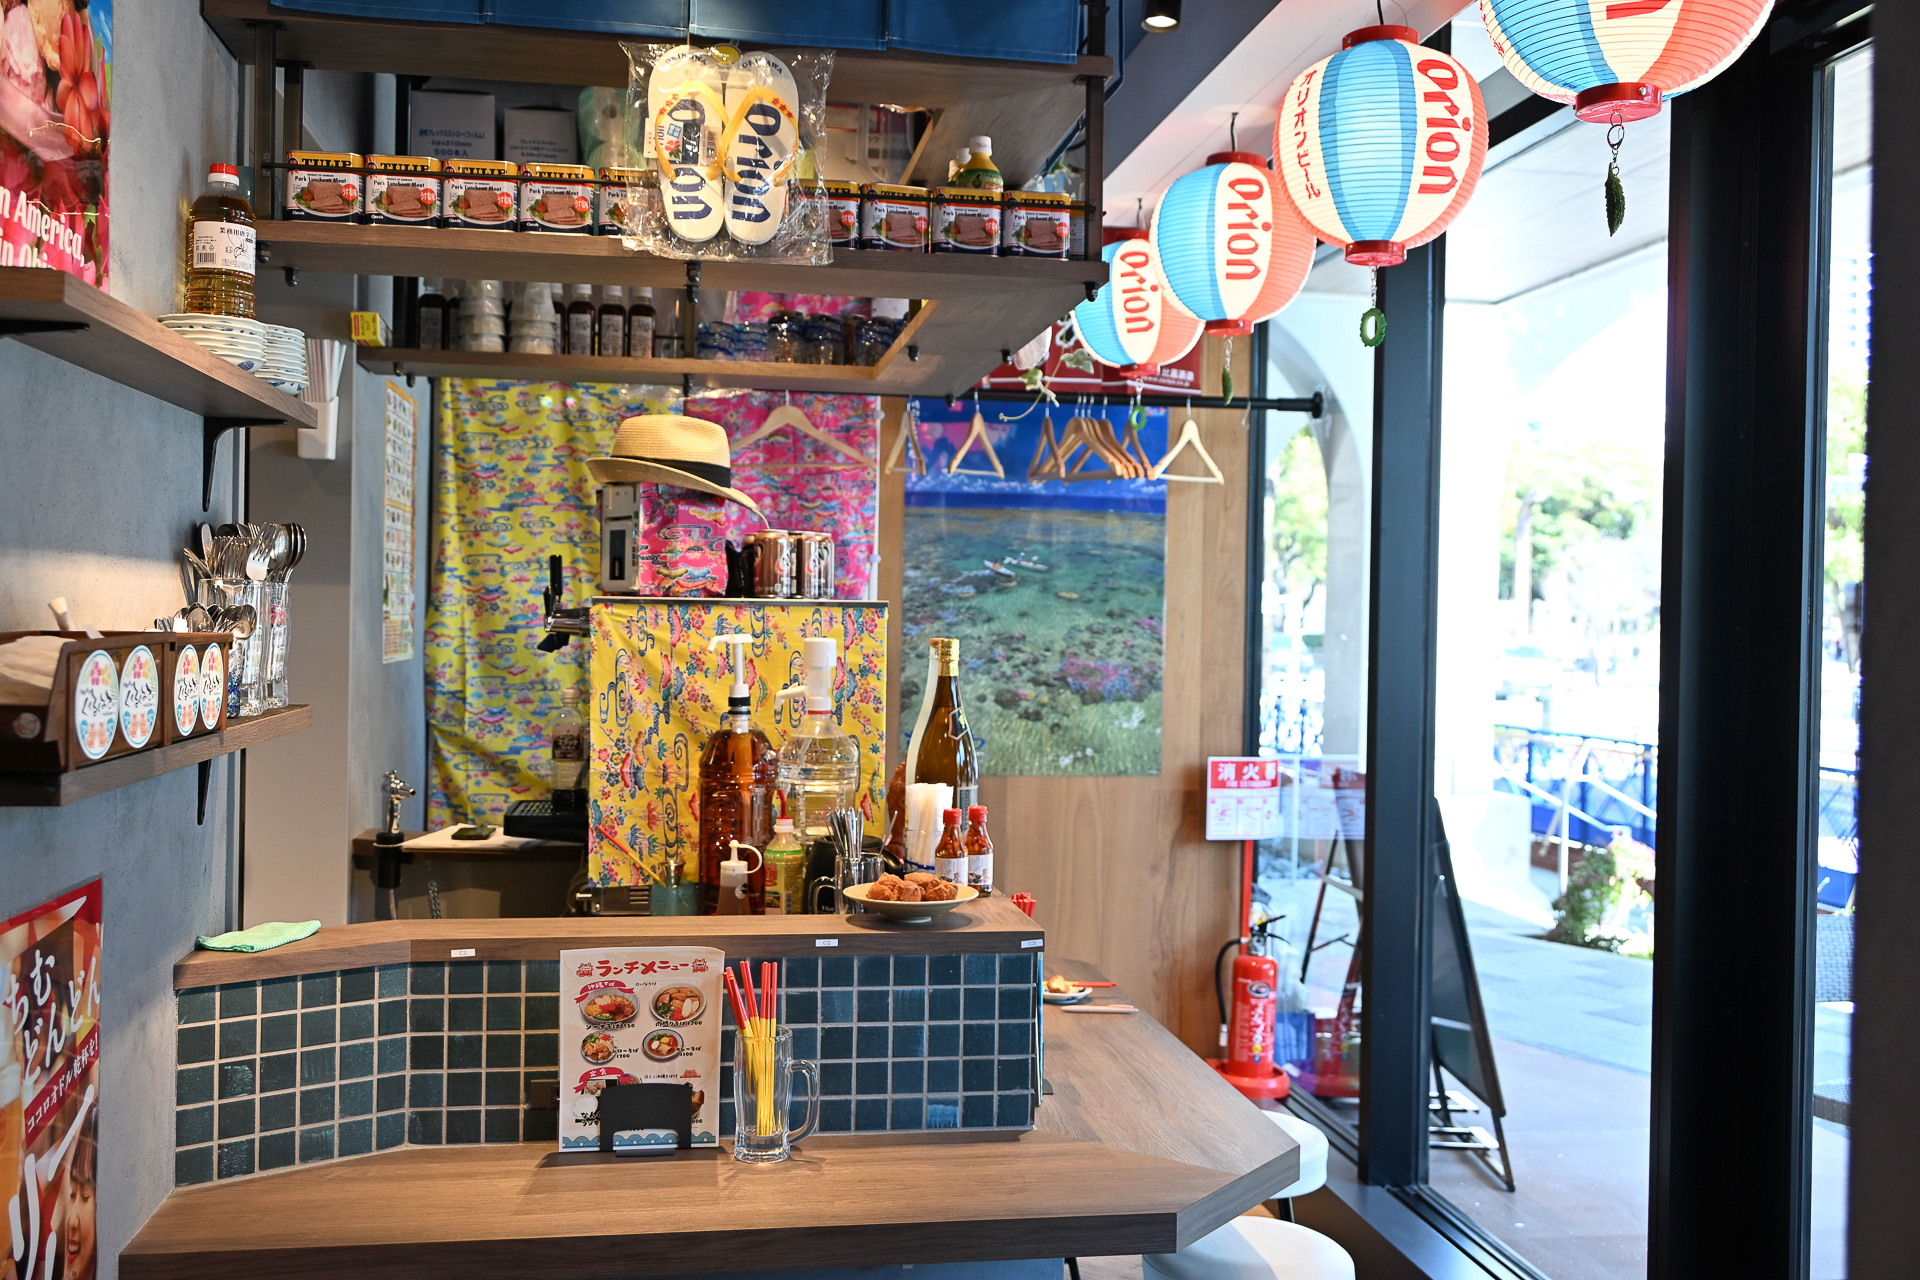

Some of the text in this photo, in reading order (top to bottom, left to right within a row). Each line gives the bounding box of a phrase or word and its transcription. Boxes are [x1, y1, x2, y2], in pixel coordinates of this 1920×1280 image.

[1294, 69, 1321, 200] オリオンビール
[1416, 58, 1472, 195] Orion
[13, 190, 85, 267] America,
[1225, 176, 1273, 281] Orion
[1119, 250, 1159, 334] Orion
[595, 959, 690, 977] ランチメニュー
